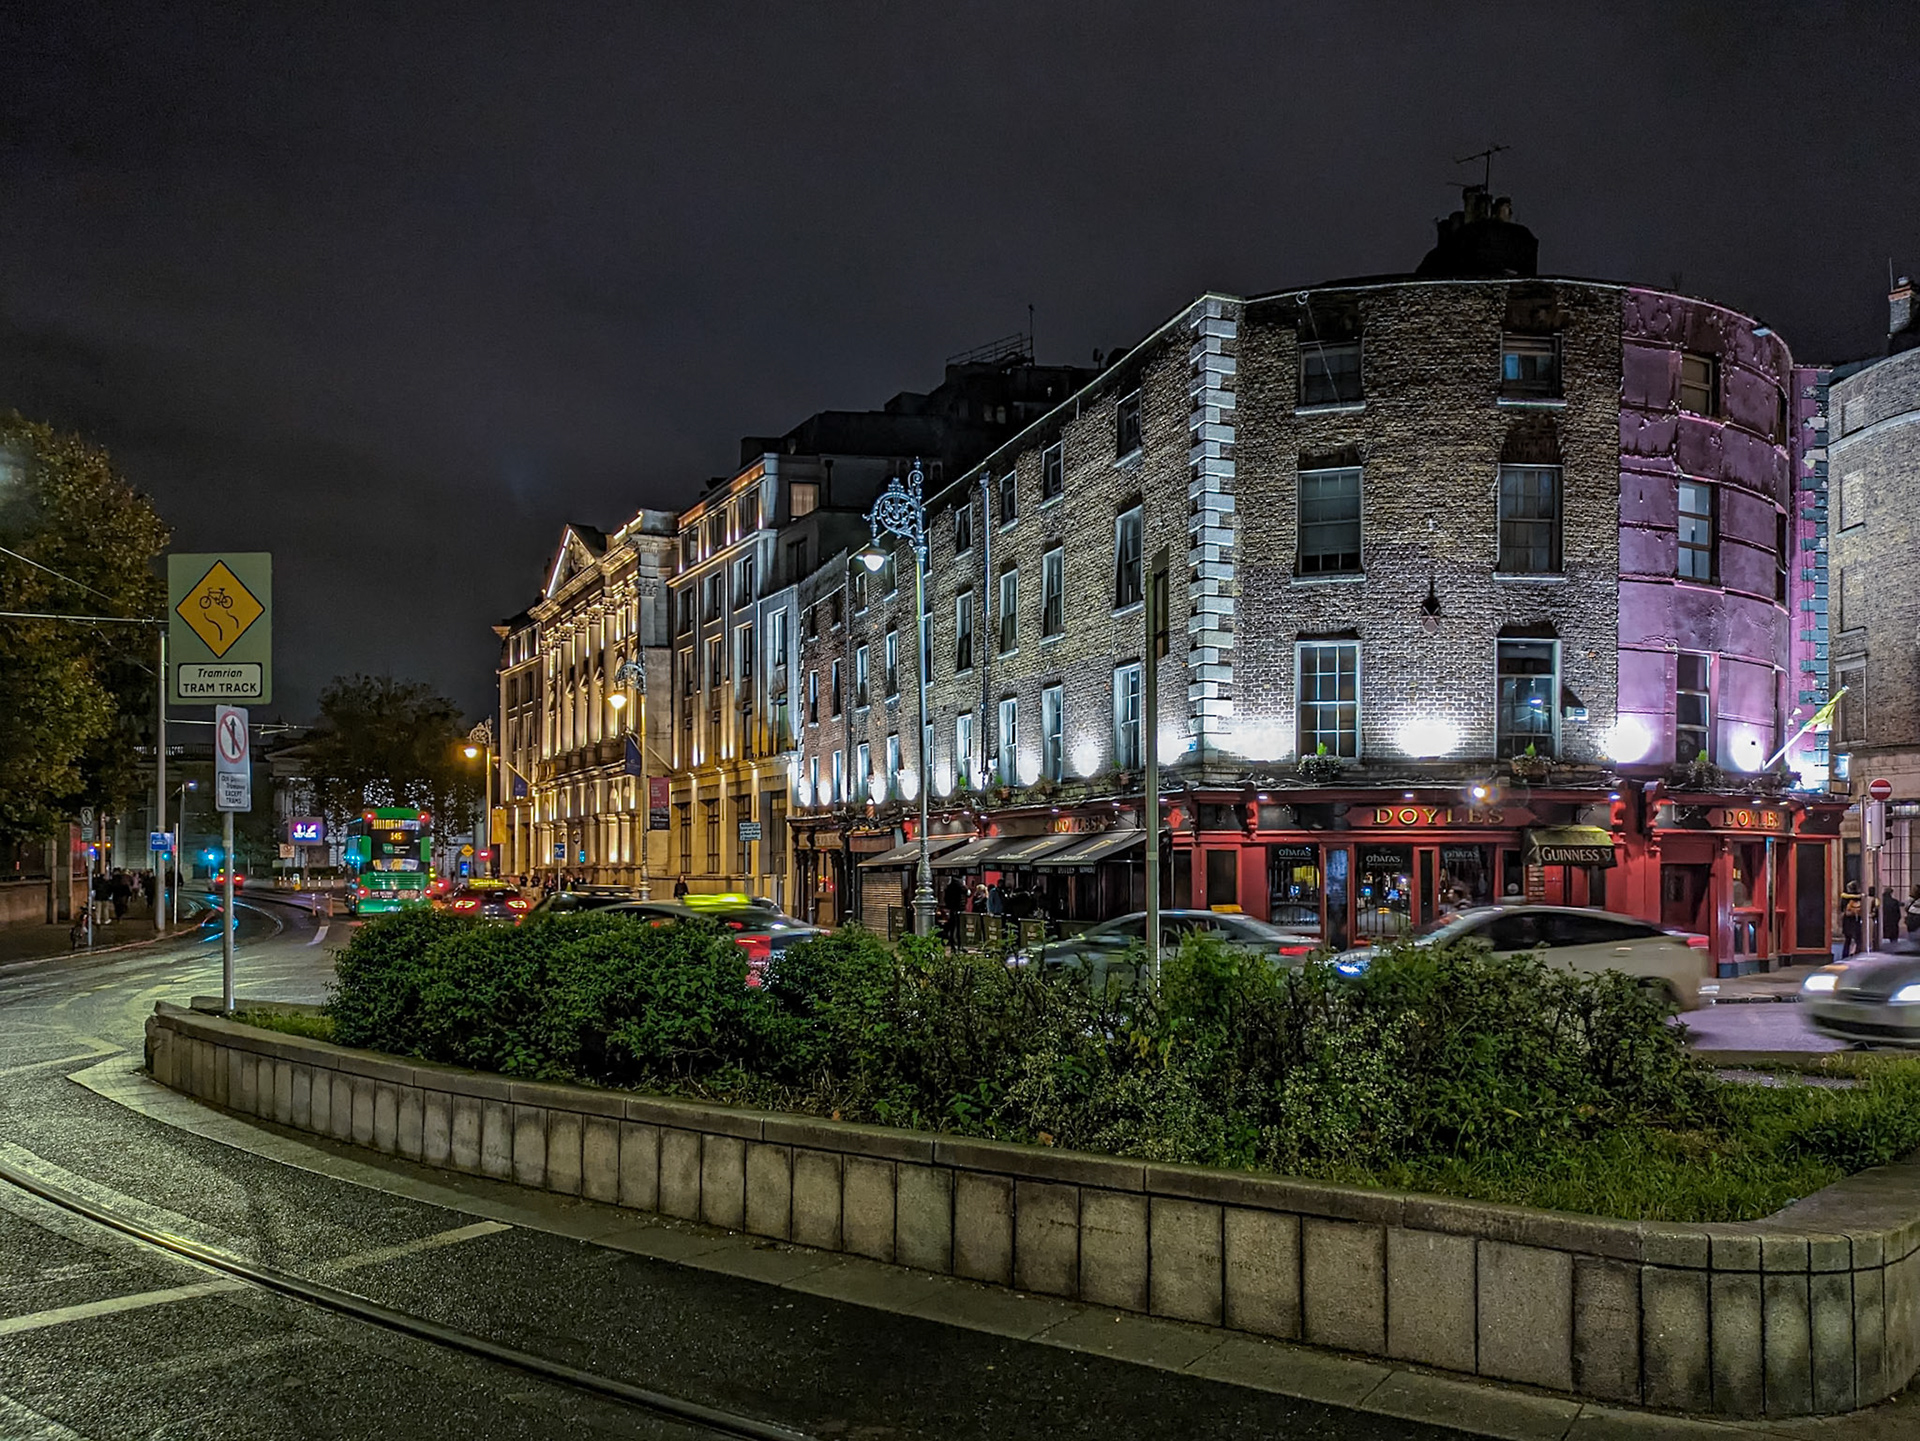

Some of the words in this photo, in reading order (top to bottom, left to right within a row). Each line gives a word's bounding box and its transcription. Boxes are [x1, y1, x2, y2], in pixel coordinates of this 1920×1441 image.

[197, 668, 243, 678] Tramrian
[183, 683, 215, 693] TRAM
[219, 683, 257, 693] TRACK
[1373, 807, 1504, 825] DOYLES
[1723, 809, 1780, 827] DOYLES
[390, 832, 402, 840] 145
[1542, 846, 1600, 862] GUINNESS
